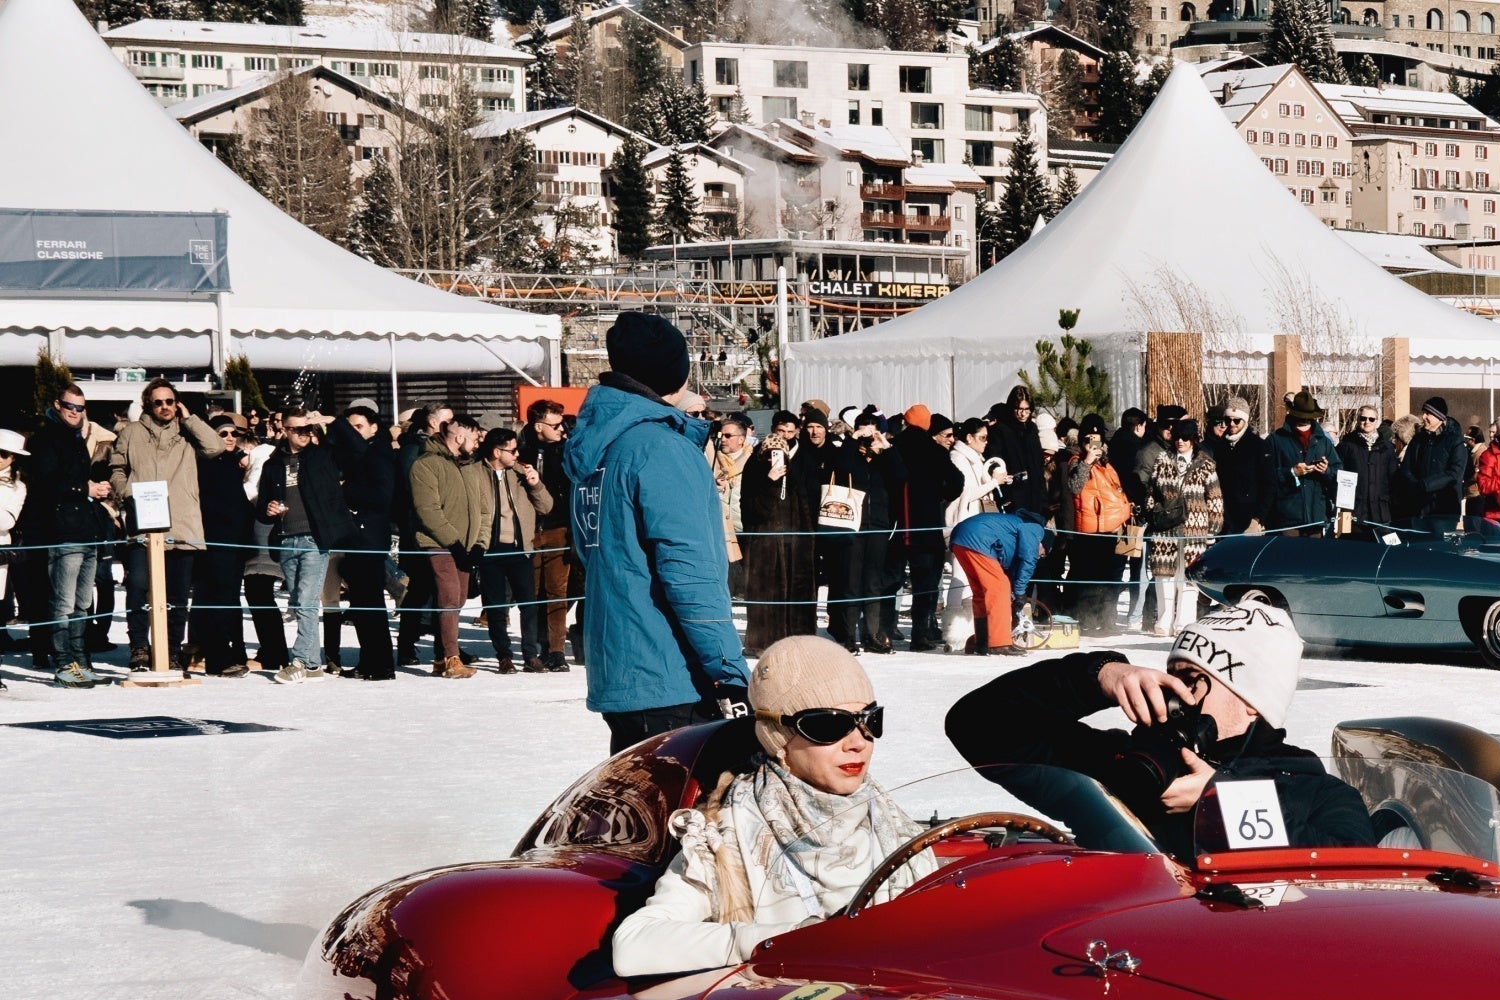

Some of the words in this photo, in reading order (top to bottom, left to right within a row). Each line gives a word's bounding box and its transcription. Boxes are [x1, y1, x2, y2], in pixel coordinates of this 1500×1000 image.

[36, 240, 87, 249] FERRARI
[194, 244, 209, 252] THE
[37, 250, 104, 260] CLASSICHE
[195, 252, 209, 260] ICE
[720, 283, 773, 295] KMERA
[809, 281, 873, 296] CHALET
[579, 486, 599, 506] THE
[582, 511, 599, 530] IC
[1238, 808, 1274, 841] 65
